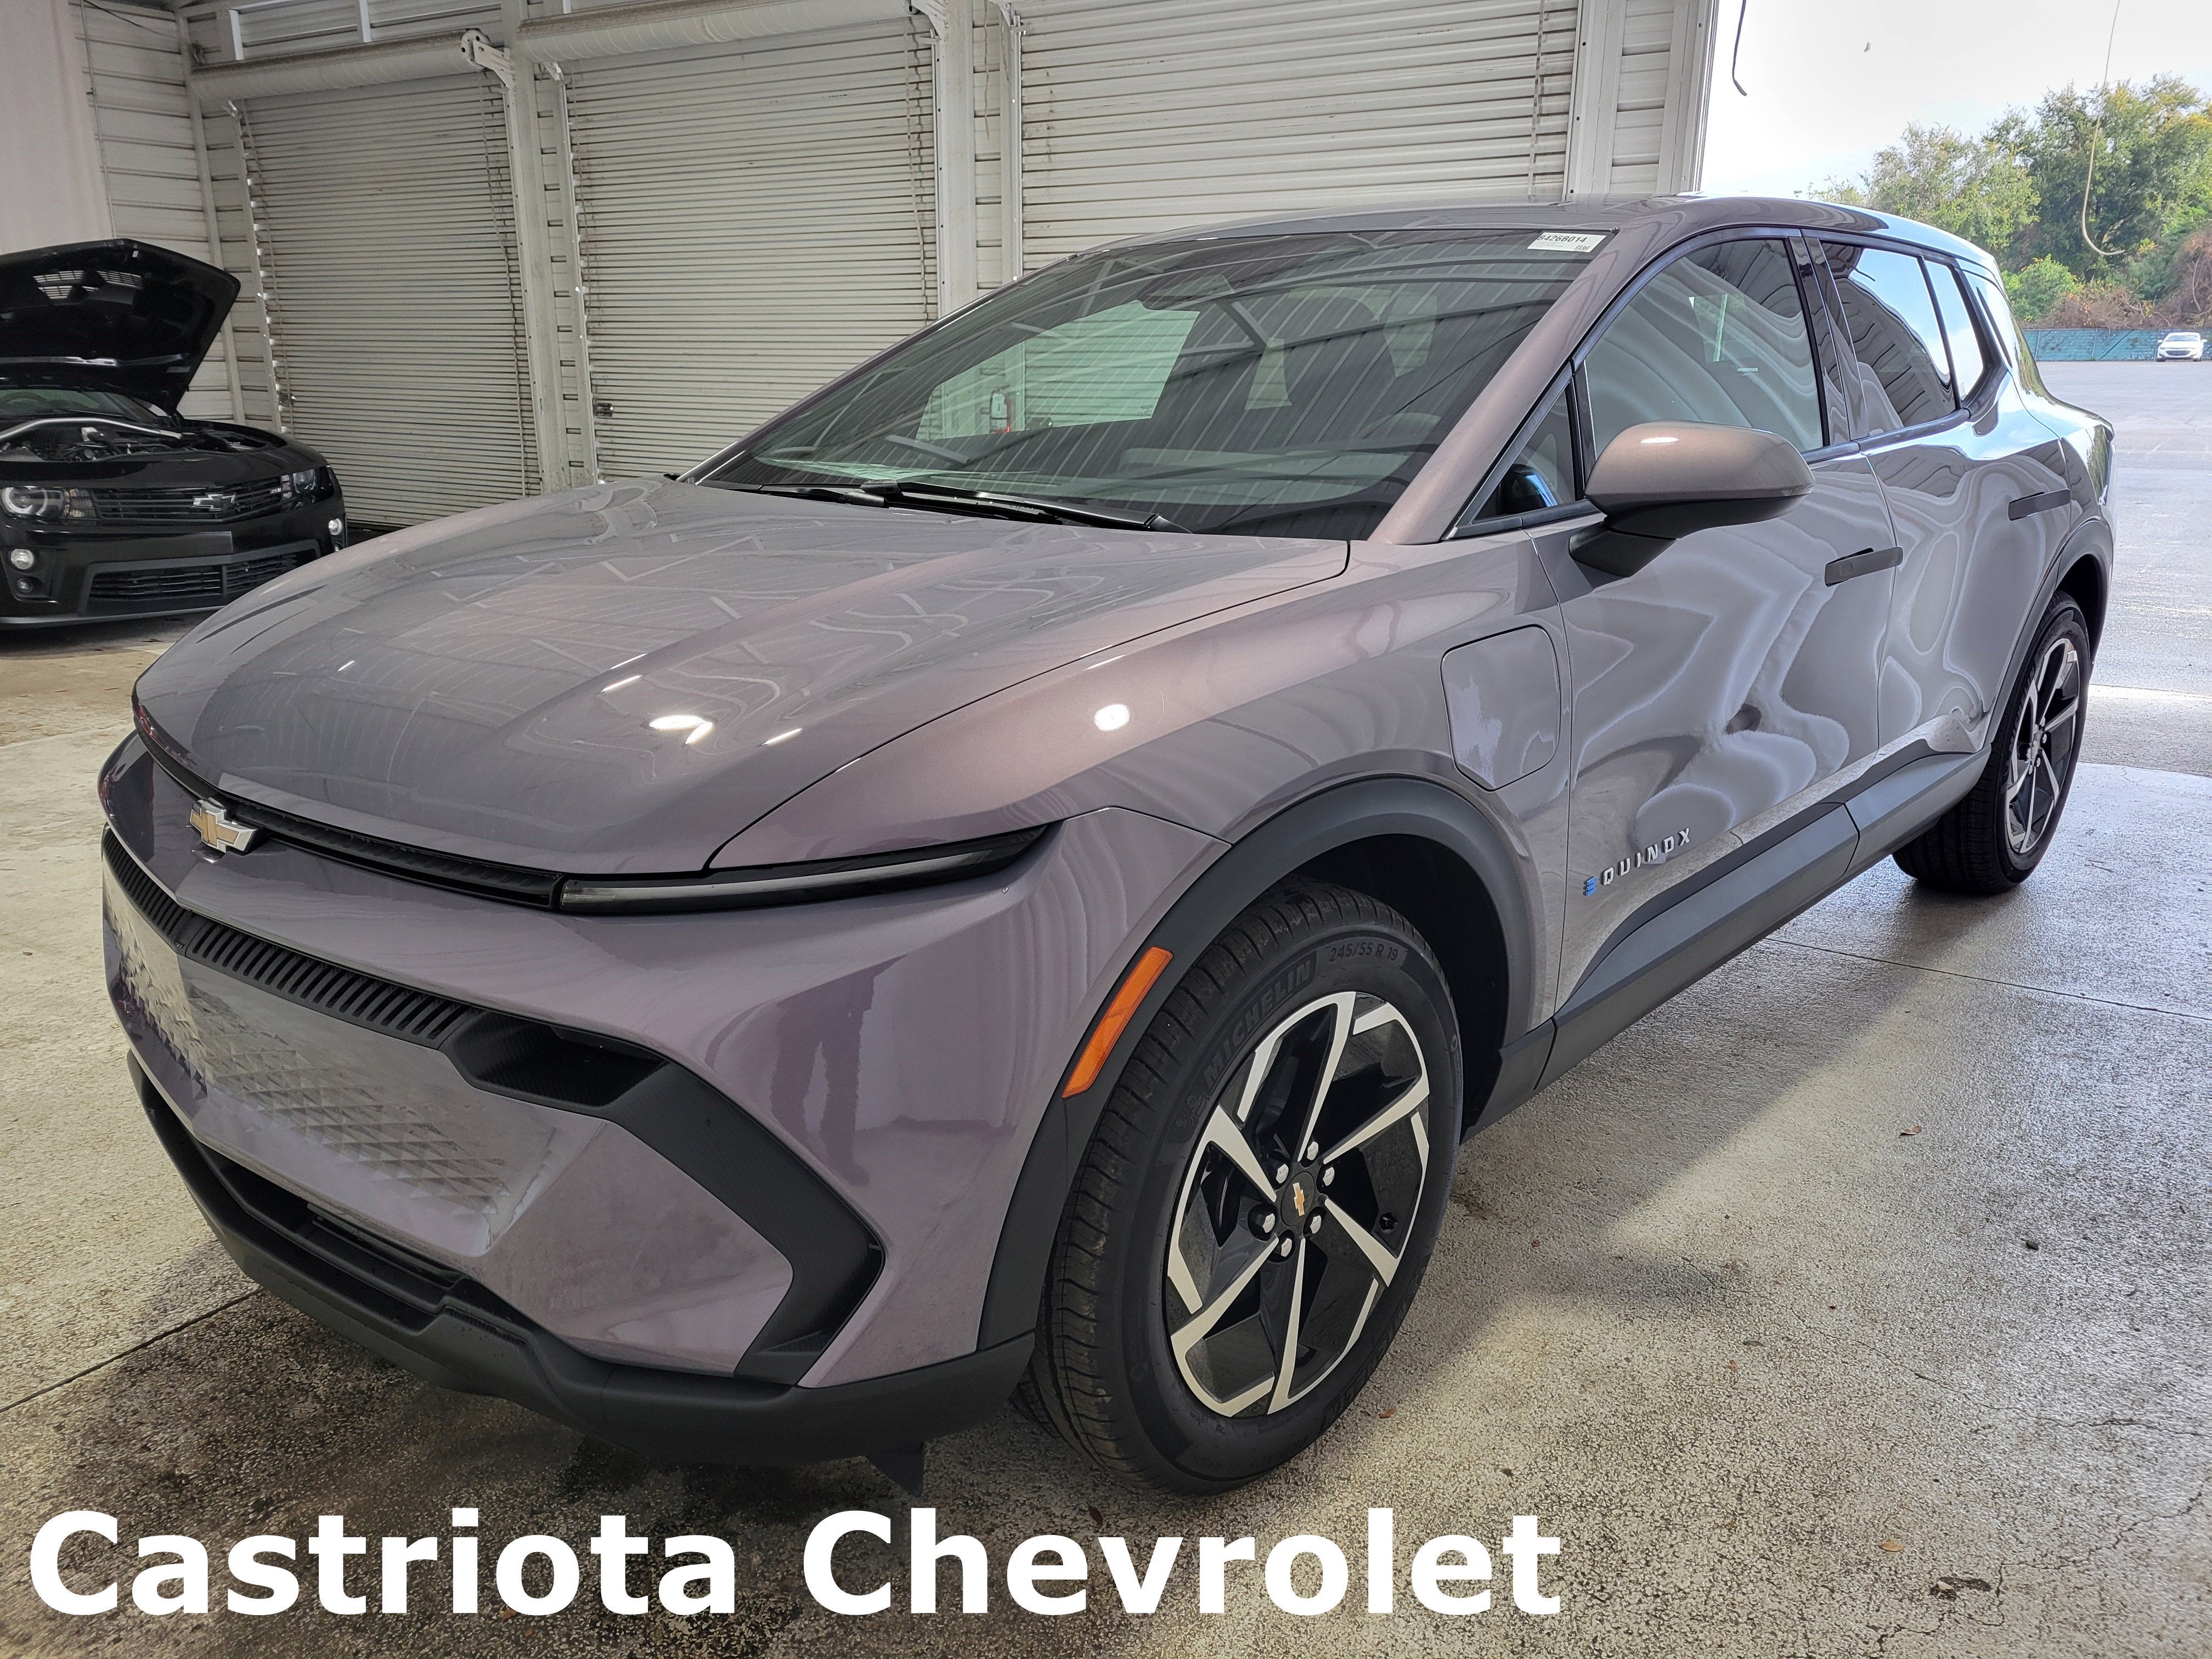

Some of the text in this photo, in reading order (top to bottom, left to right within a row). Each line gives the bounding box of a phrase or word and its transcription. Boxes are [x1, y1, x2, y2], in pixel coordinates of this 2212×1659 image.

[1330, 942, 1398, 962] 245/55 R 19
[1204, 960, 1311, 1089] MICHELIN
